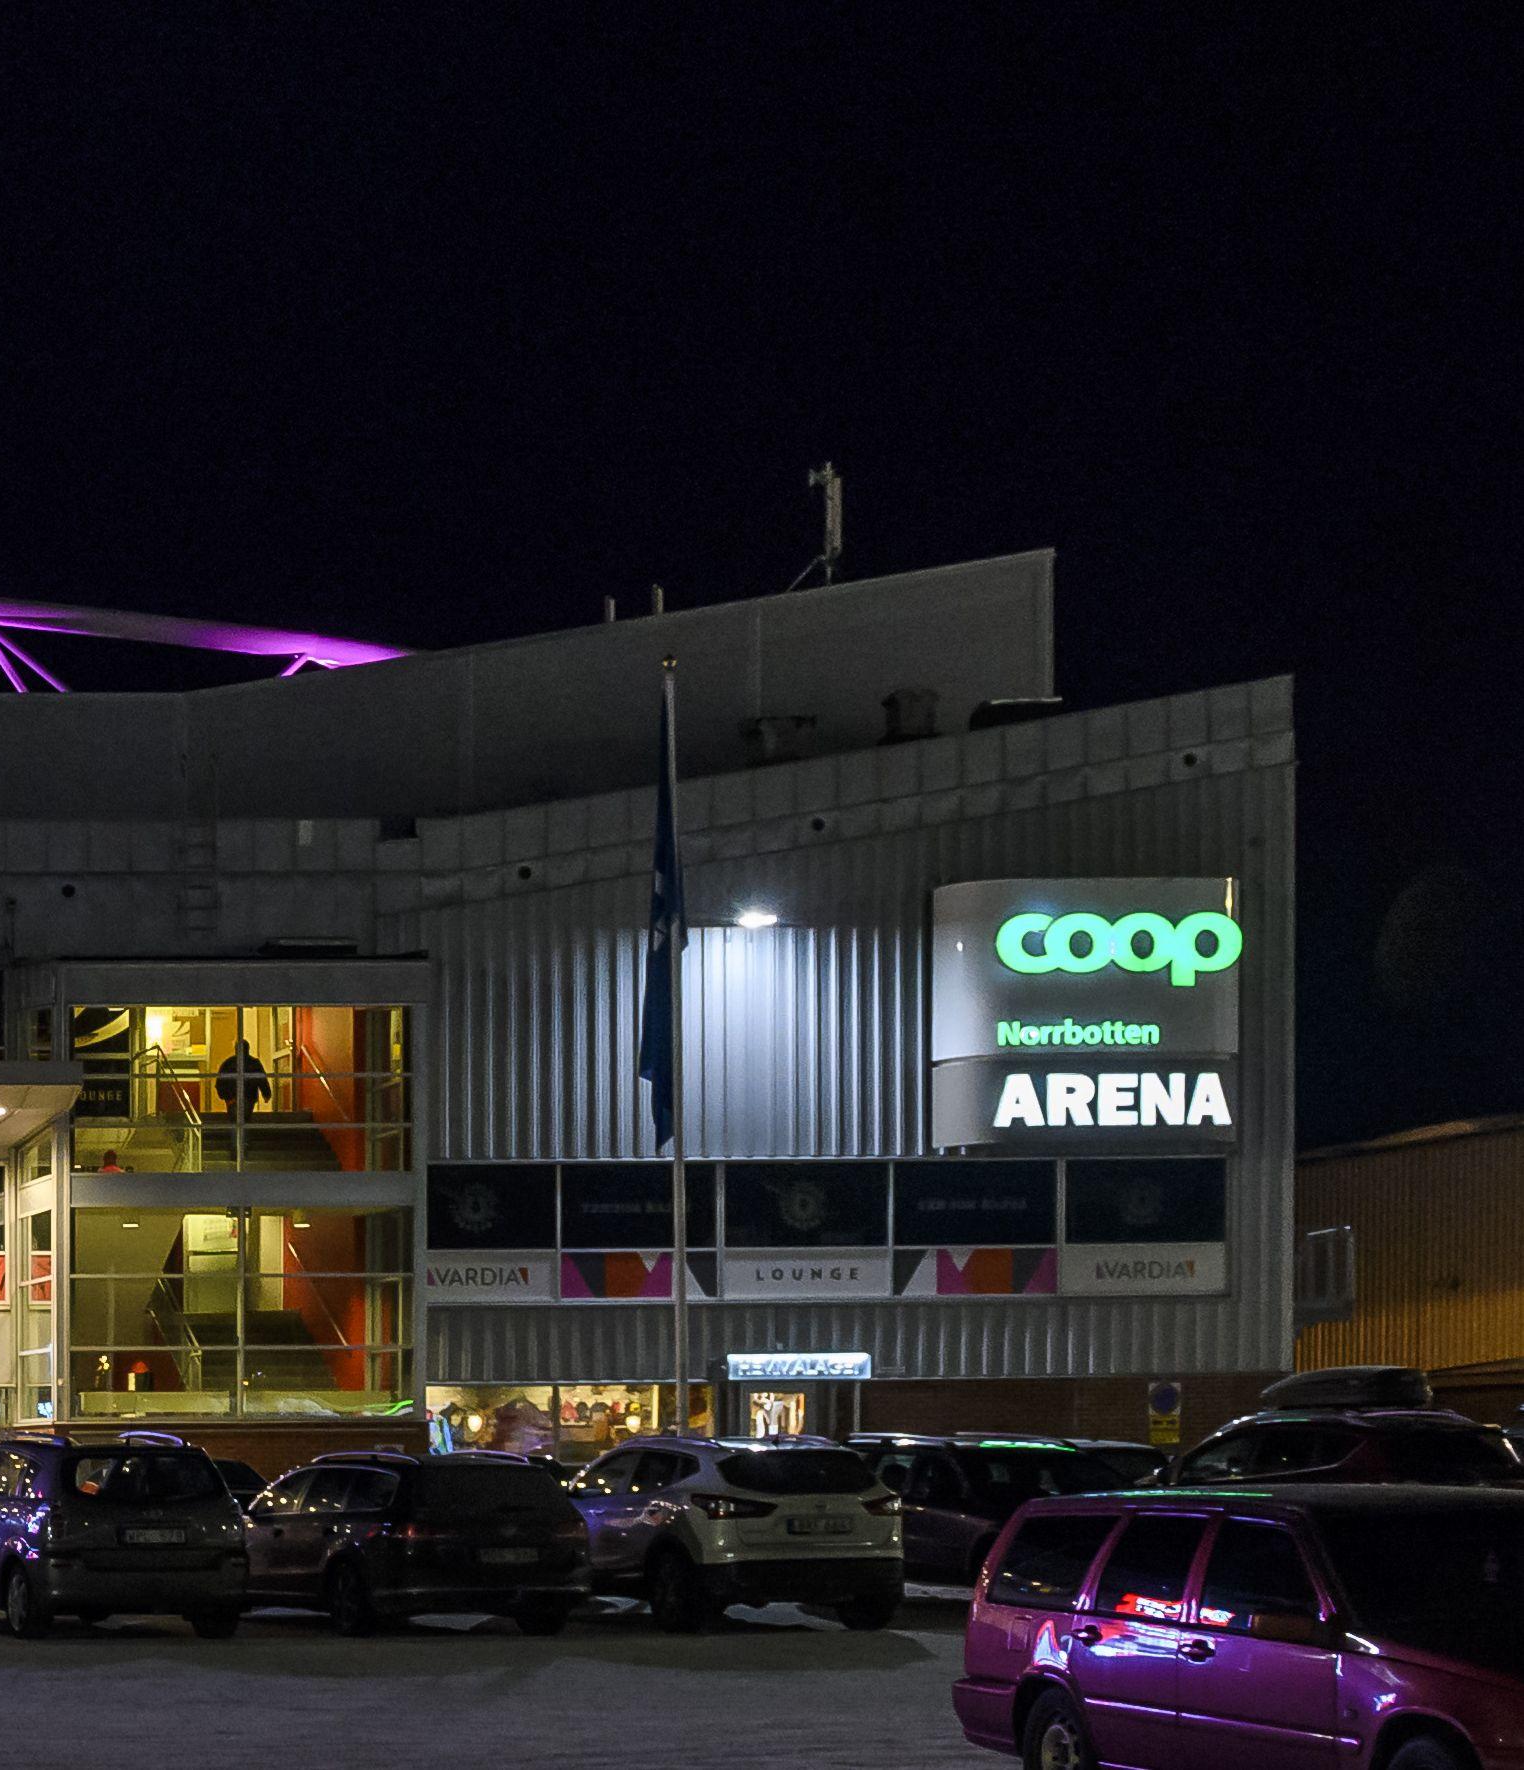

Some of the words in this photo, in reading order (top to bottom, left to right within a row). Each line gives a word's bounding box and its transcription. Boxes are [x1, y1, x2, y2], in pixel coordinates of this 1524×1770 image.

[995, 911, 1244, 988] coop
[997, 1018, 1160, 1047] Norrbotten
[994, 1072, 1232, 1128] ARENA
[434, 1267, 520, 1287] VARDIA
[755, 1266, 860, 1282] LOUNGE
[1104, 1262, 1186, 1280] VARDIA
